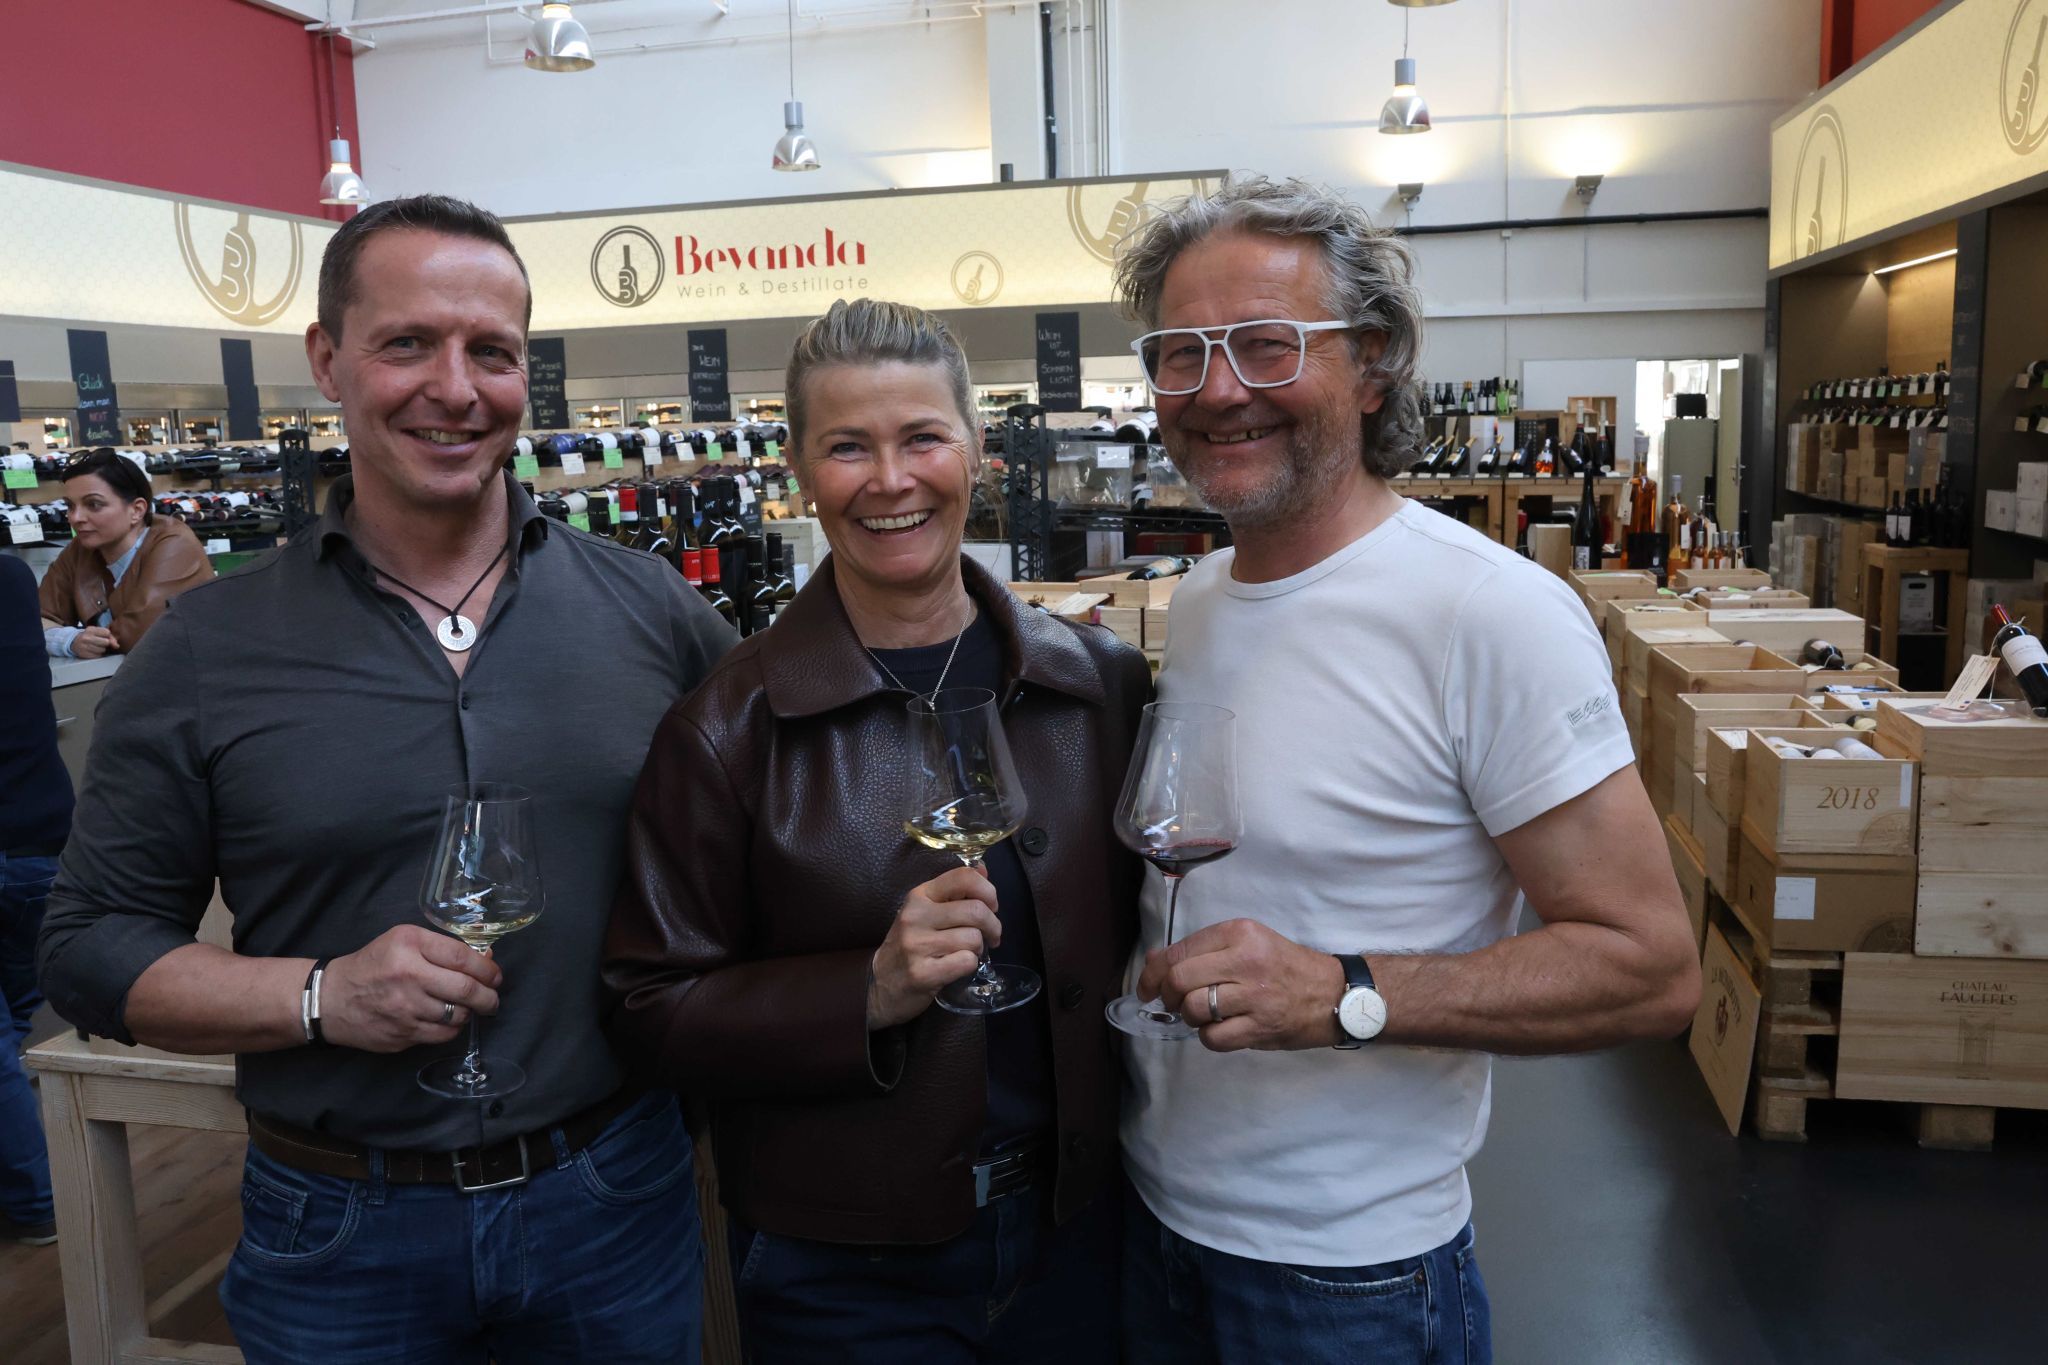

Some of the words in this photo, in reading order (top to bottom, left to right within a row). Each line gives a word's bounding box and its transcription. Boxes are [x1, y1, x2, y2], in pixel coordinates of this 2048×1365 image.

[674, 227, 866, 276] Bevanda
[677, 283, 727, 298] Wein
[739, 281, 750, 296] &
[762, 276, 869, 295] Destillate
[1816, 786, 1880, 810] 2018
